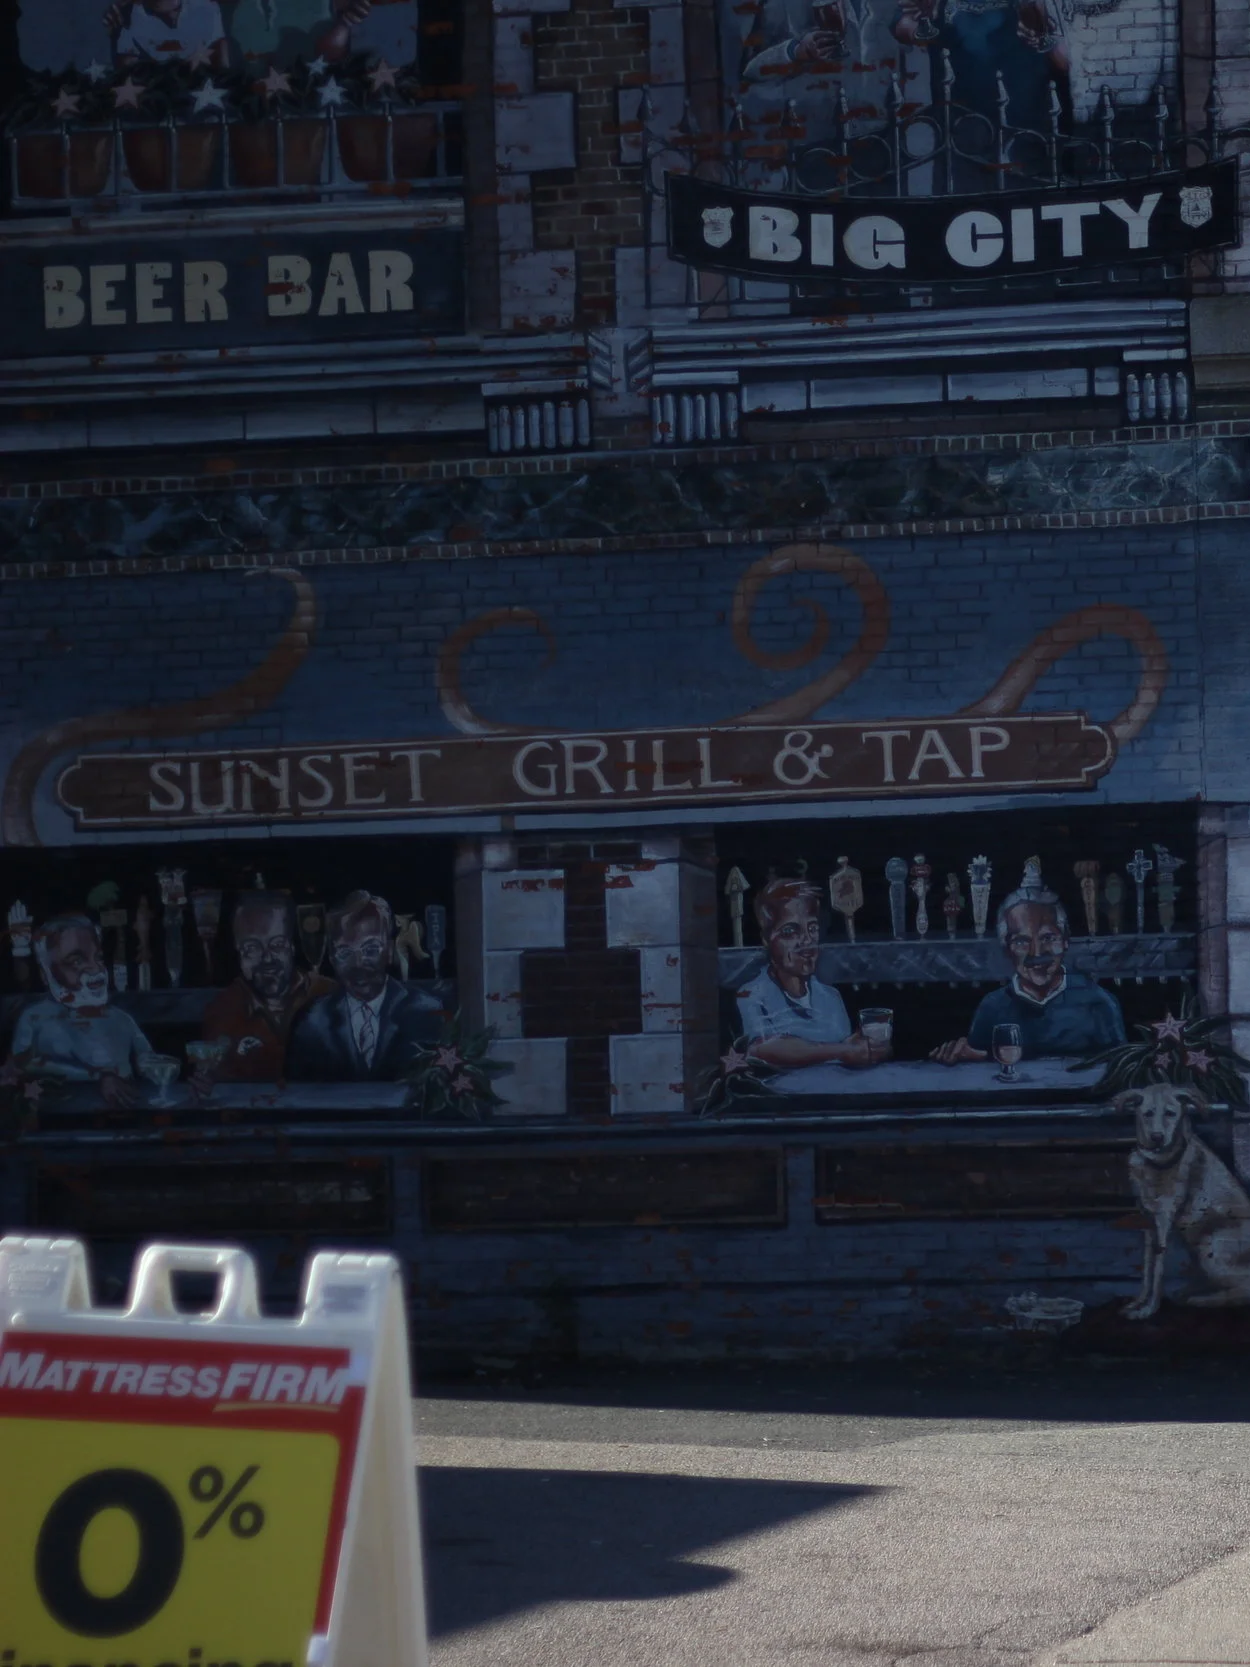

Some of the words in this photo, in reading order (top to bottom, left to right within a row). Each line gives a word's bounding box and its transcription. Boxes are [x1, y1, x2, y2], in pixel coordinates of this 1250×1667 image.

[748, 205, 907, 270] BIG
[944, 192, 1164, 268] CITY
[43, 261, 229, 329] BEER
[267, 250, 414, 317] BAR
[147, 748, 441, 815] SUNSET
[512, 737, 743, 796] GRILL
[773, 729, 834, 785] &
[861, 726, 1011, 783] TAP
[35, 1464, 265, 1639] 0%
